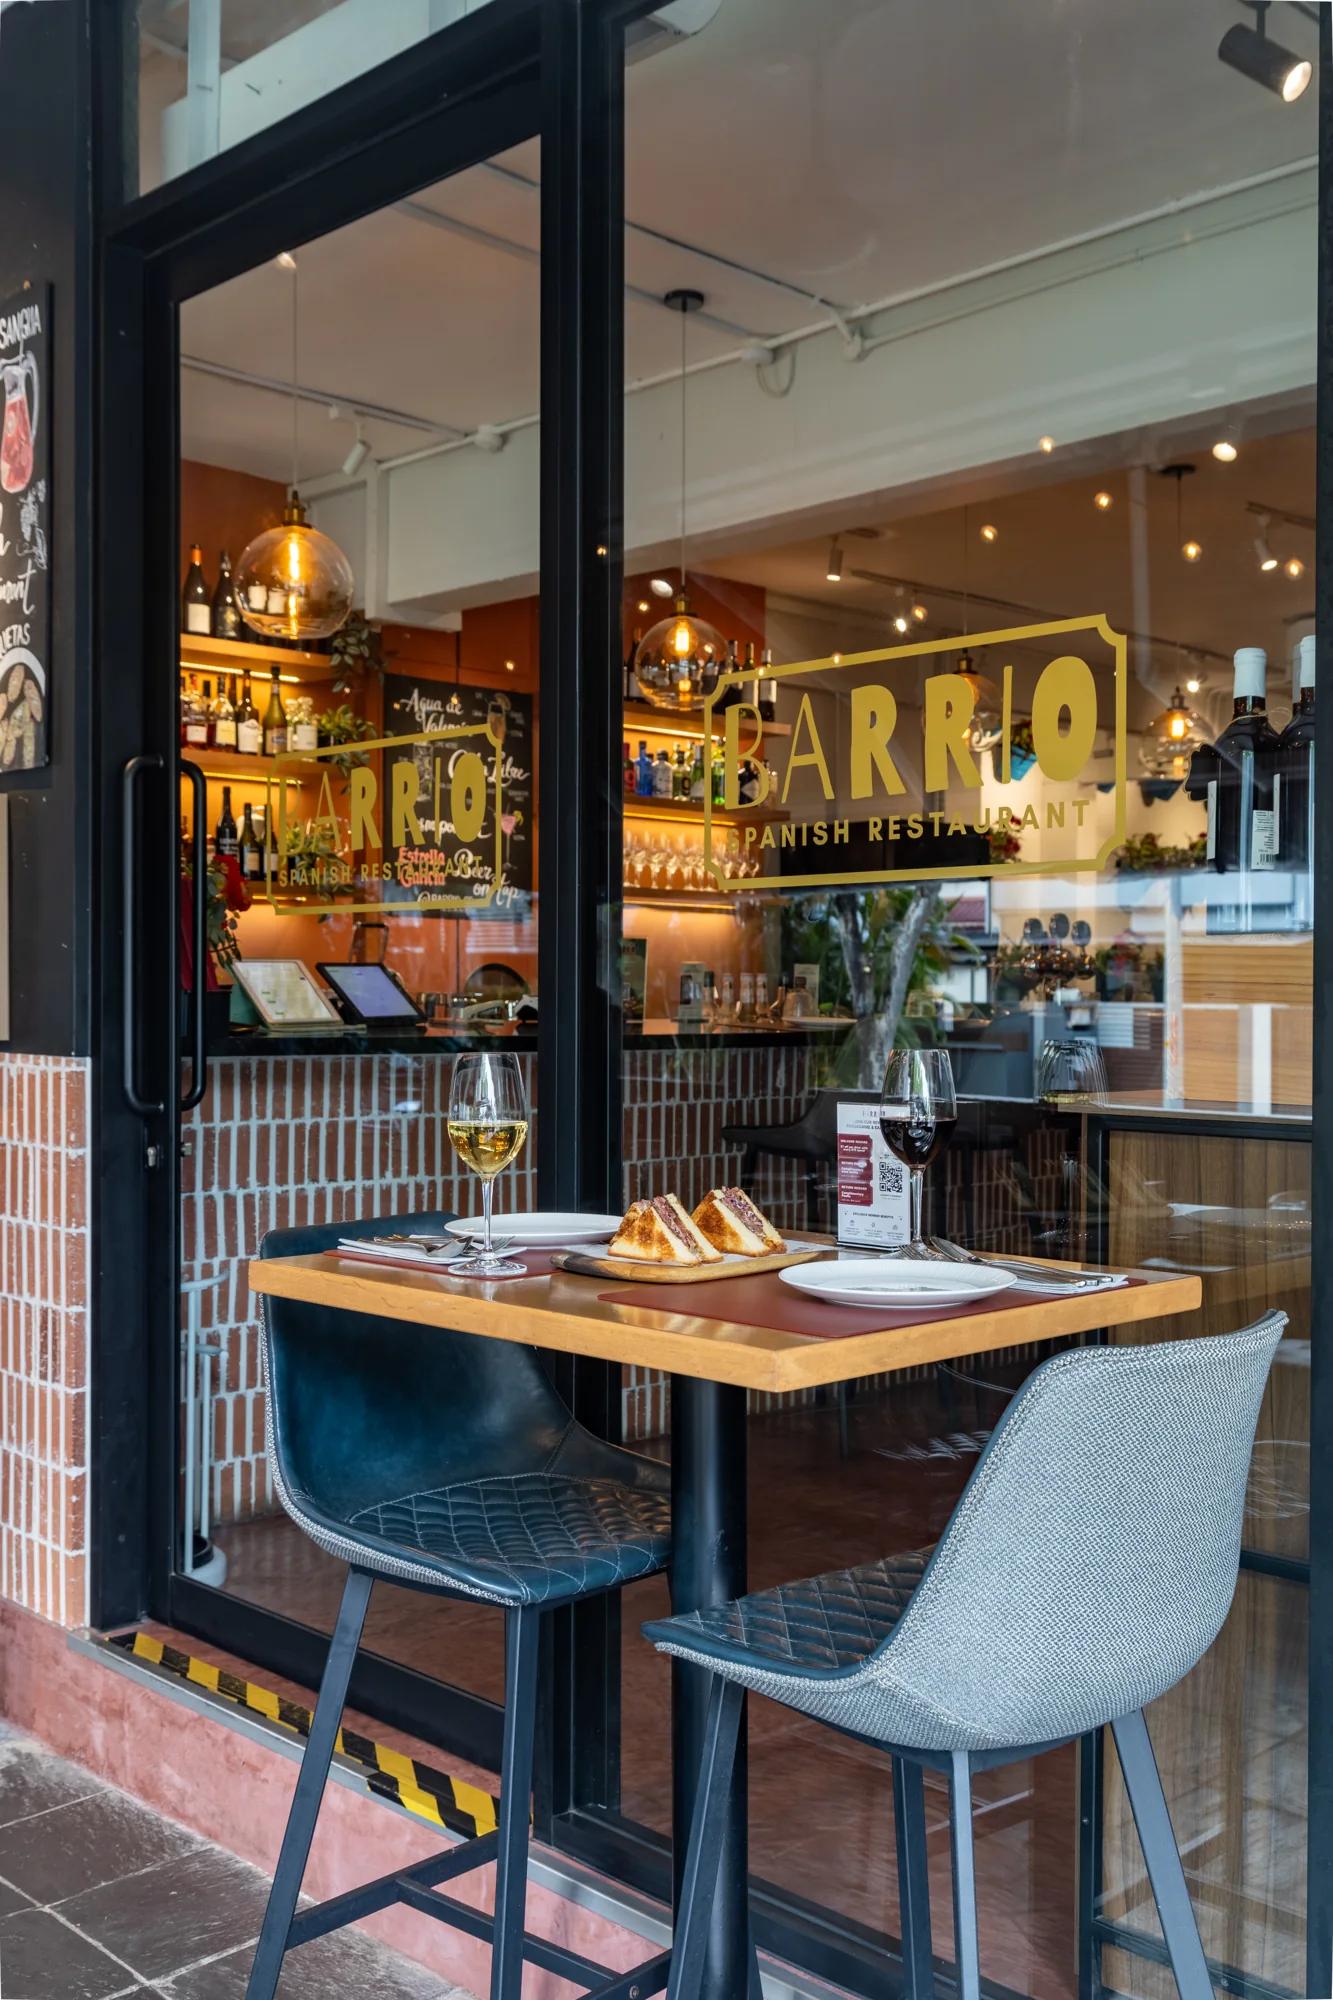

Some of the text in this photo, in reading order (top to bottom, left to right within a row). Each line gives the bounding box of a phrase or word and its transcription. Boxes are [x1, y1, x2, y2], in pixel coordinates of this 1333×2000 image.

[400, 688, 443, 722] Agua
[725, 656, 1098, 810] BARRIO
[278, 752, 487, 856] BARRIO
[727, 799, 1090, 853] SPANISH RESTAURANT
[279, 855, 483, 888] SPANISH RESTAURANT
[399, 846, 446, 866] Estrella
